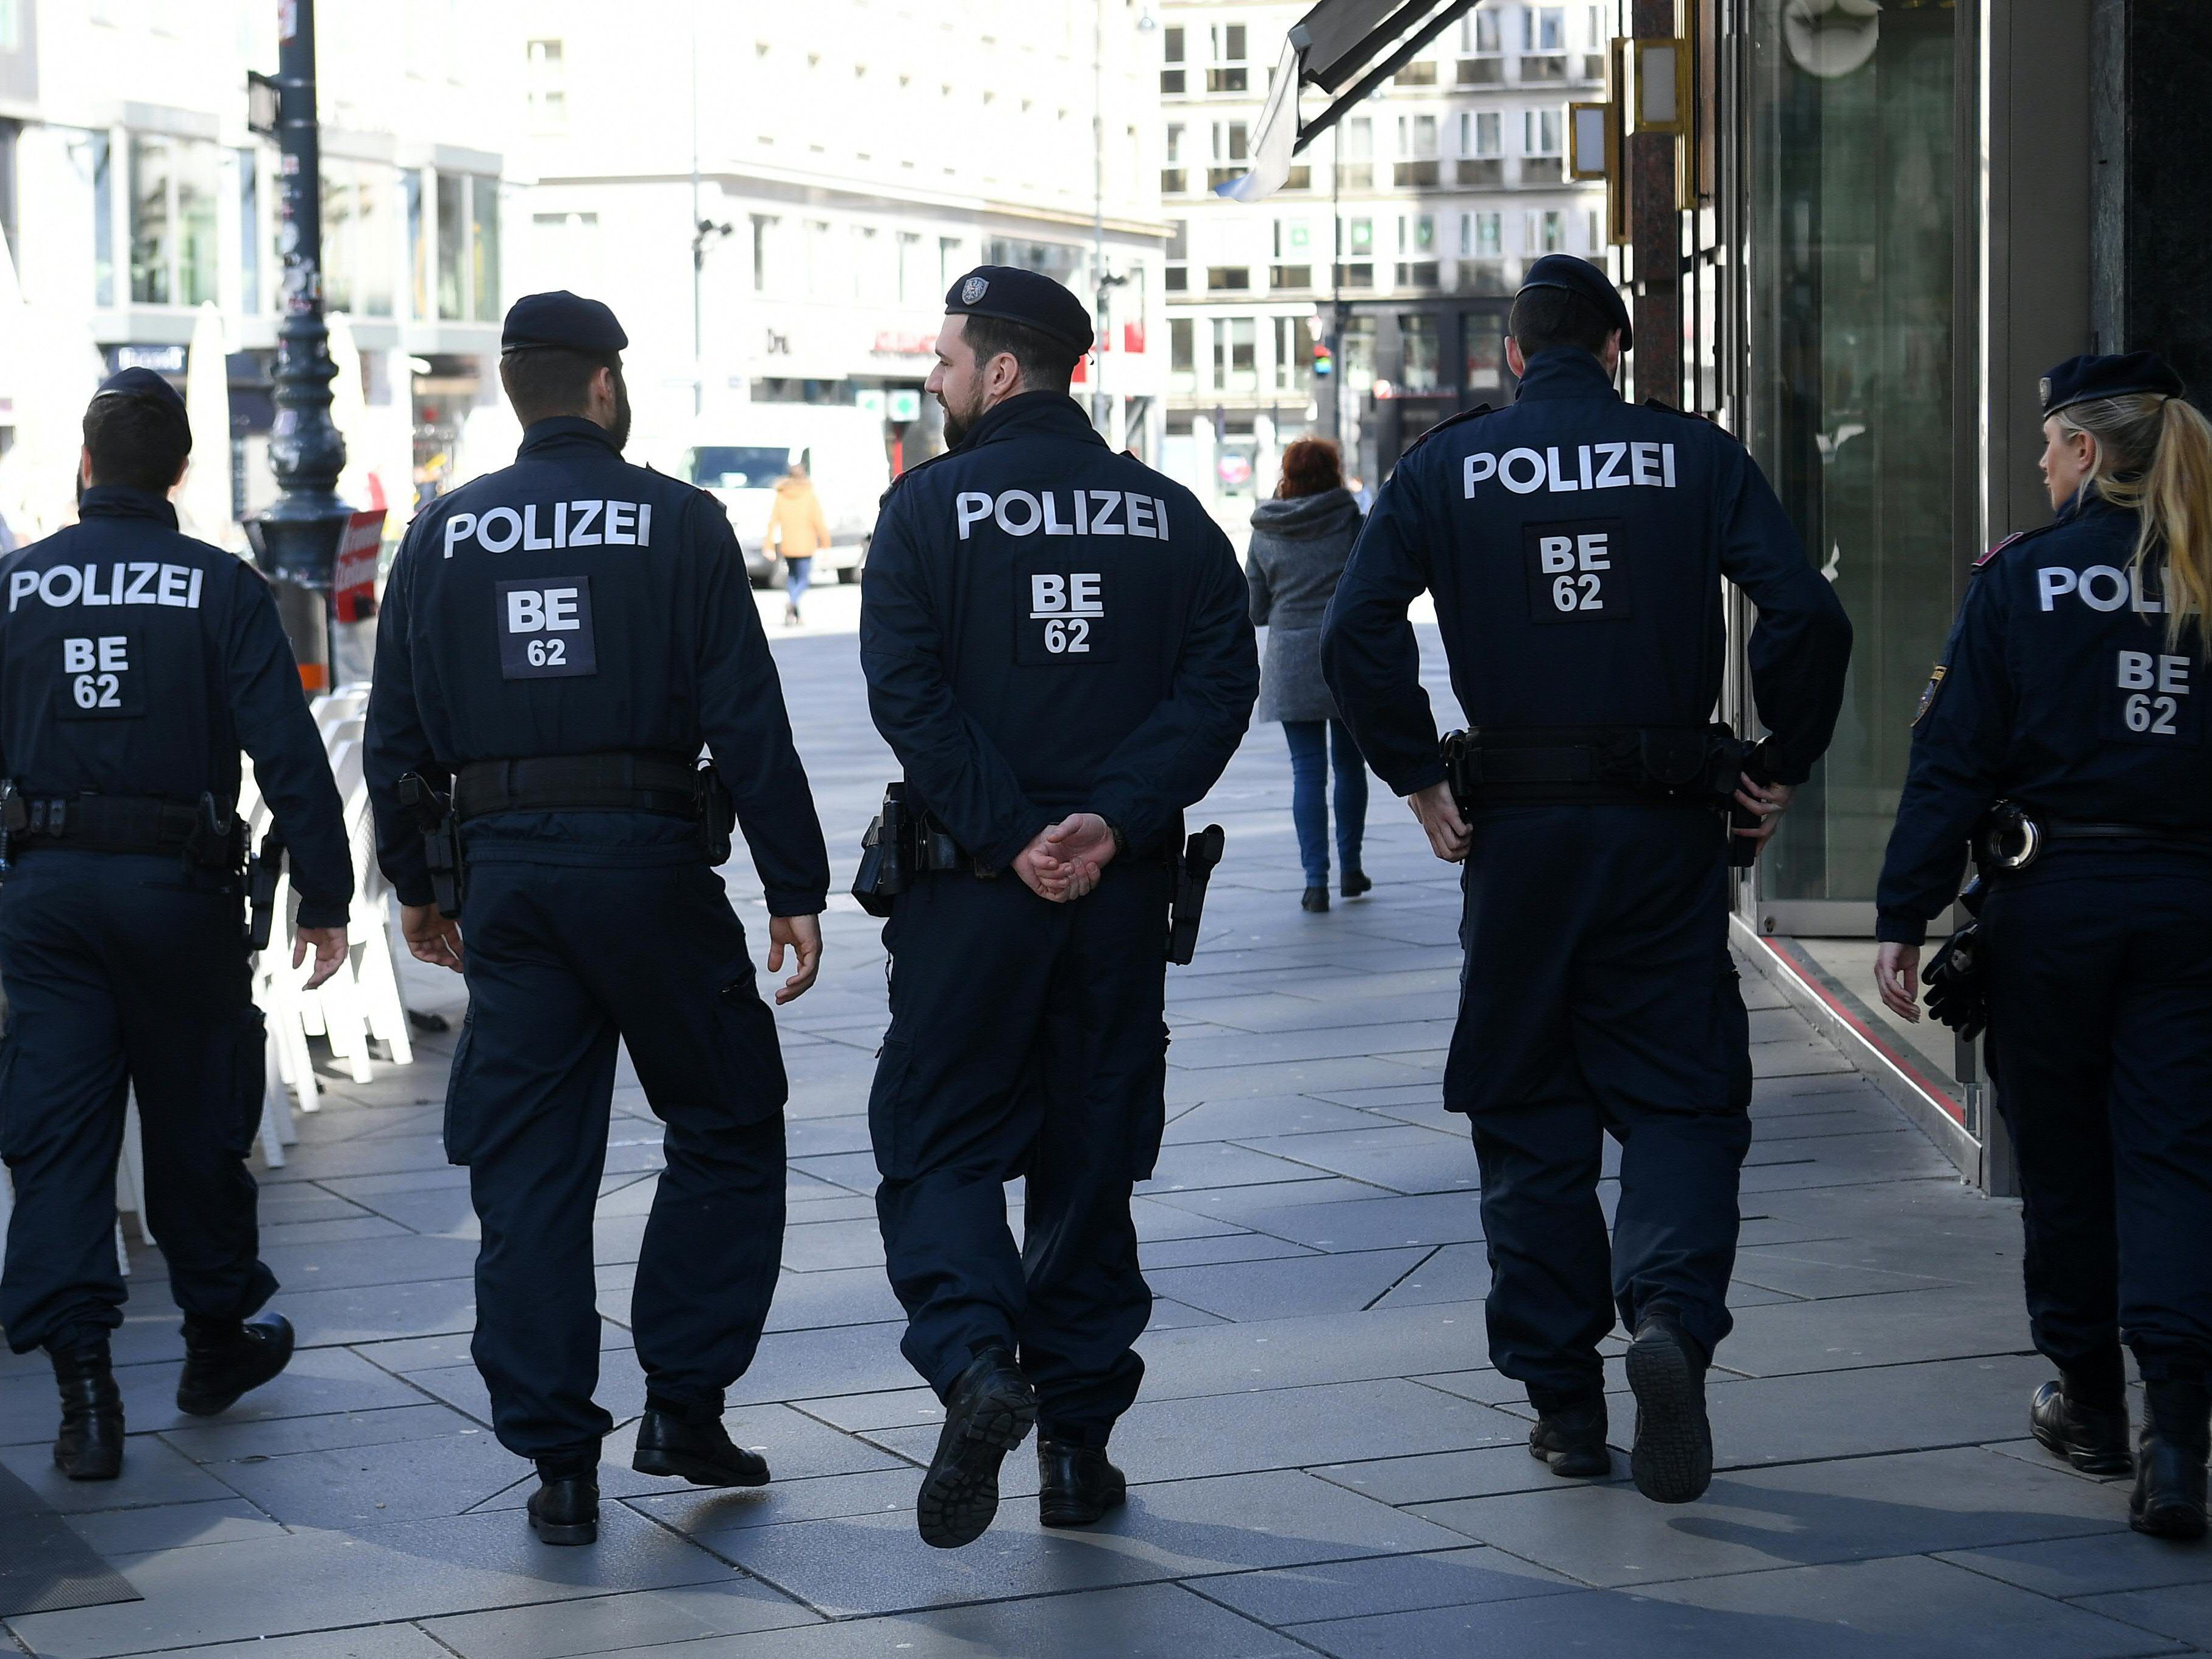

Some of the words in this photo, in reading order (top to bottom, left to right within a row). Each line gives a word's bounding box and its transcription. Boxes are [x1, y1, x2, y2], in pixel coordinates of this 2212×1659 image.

[1463, 441, 1677, 499] POLIZEI
[443, 500, 652, 560] POLIZEI
[955, 489, 1170, 541] POLIZEI
[1539, 533, 1611, 574] BE
[9, 562, 204, 613] POLIZEI
[1031, 573, 1103, 612] BE
[1552, 574, 1604, 613] 62
[2038, 564, 2202, 614] POLI
[507, 588, 581, 633] BE
[63, 636, 129, 674] BE
[527, 639, 567, 667] 62
[1044, 618, 1090, 654] 62
[72, 673, 122, 709] 62
[2118, 650, 2191, 695] BE
[2125, 694, 2178, 735] 62
